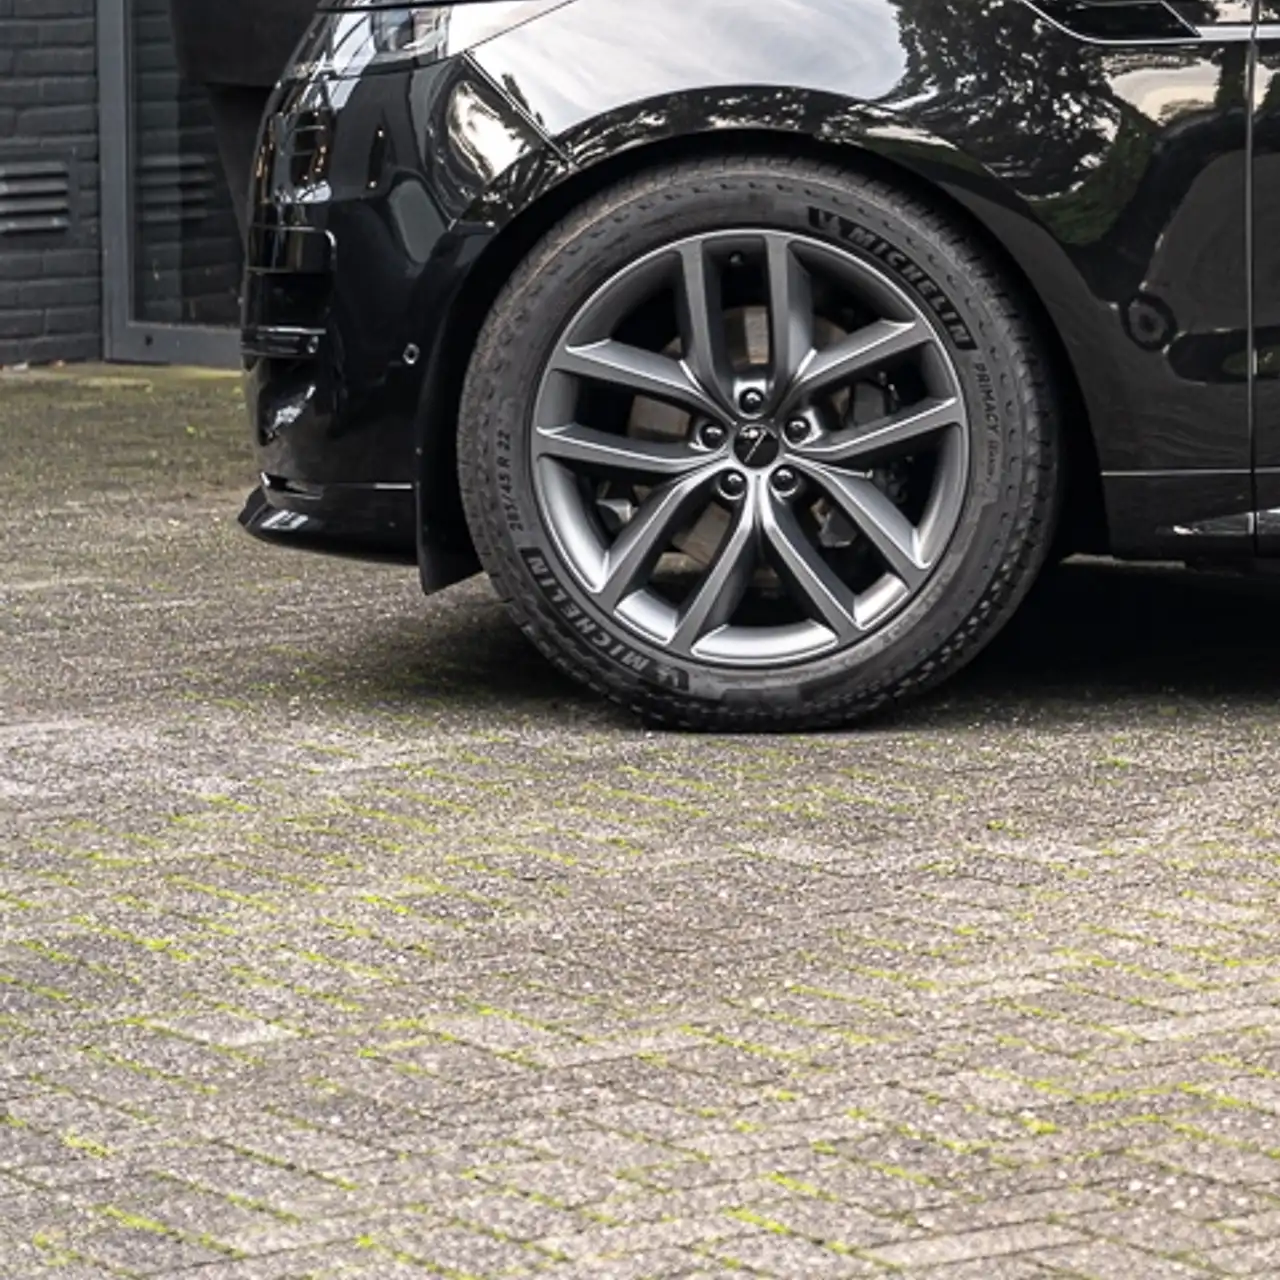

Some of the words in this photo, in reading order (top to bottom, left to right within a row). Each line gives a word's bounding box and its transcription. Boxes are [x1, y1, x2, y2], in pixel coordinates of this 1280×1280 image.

[846, 227, 973, 350] MICHELIN
[973, 362, 1000, 435] PRIMACY
[526, 555, 651, 672] MICHELIN
